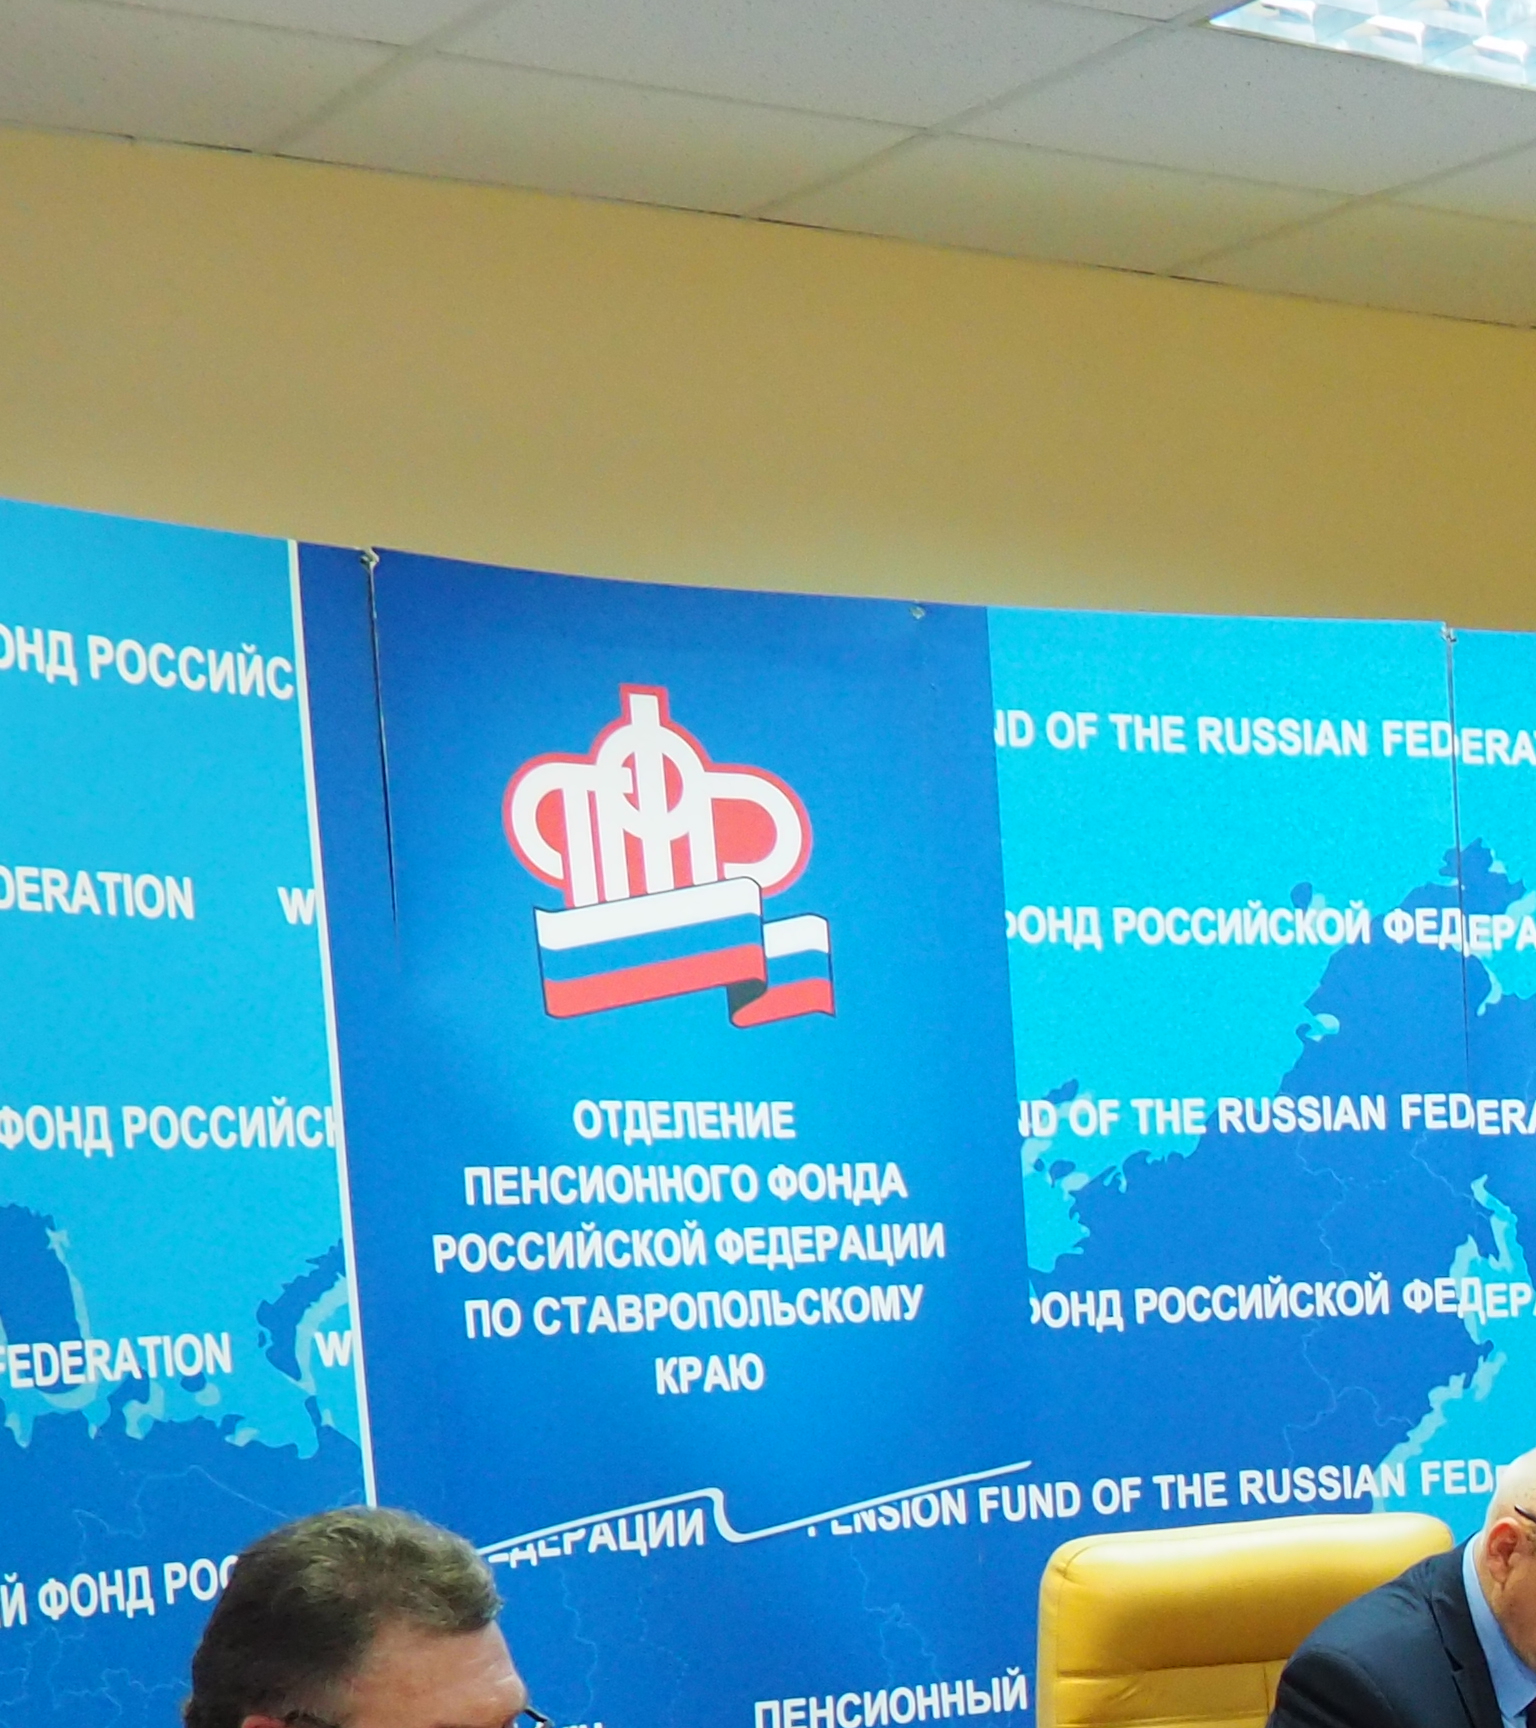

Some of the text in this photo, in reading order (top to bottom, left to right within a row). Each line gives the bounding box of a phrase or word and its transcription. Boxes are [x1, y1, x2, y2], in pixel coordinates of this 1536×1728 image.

[88, 633, 294, 700] РОССИЙС
[1045, 711, 1098, 750] OF
[1109, 713, 1187, 753] THE
[1197, 716, 1368, 757] RUSSIAN
[1113, 899, 1371, 946] РОССИЙСКОЙ
[572, 1099, 796, 1146] ОТДЕЛЕНИЕ
[1069, 1099, 1120, 1137] OF
[1131, 1098, 1207, 1135] THE
[1217, 1095, 1387, 1134] RUSSIAN
[464, 1161, 909, 1206] ПЕНСИОННОГО ФОНДА
[432, 1220, 946, 1274] РОССИЙСКОЙ ФЕДЕРАЦИИ
[464, 1283, 924, 1339] ПО СТАВРОПОЛЬСКОМУ
[1134, 1271, 1391, 1326] РОССИЙСКОЙ
[0, 1331, 232, 1389] EDERATION
[655, 1352, 765, 1396] КРАЮ
[979, 1482, 1081, 1524] FUND
[1091, 1476, 1142, 1515] OF
[1153, 1471, 1228, 1511] THE
[1239, 1463, 1406, 1504] RUSSIAN
[38, 1565, 155, 1620] ФОНД
